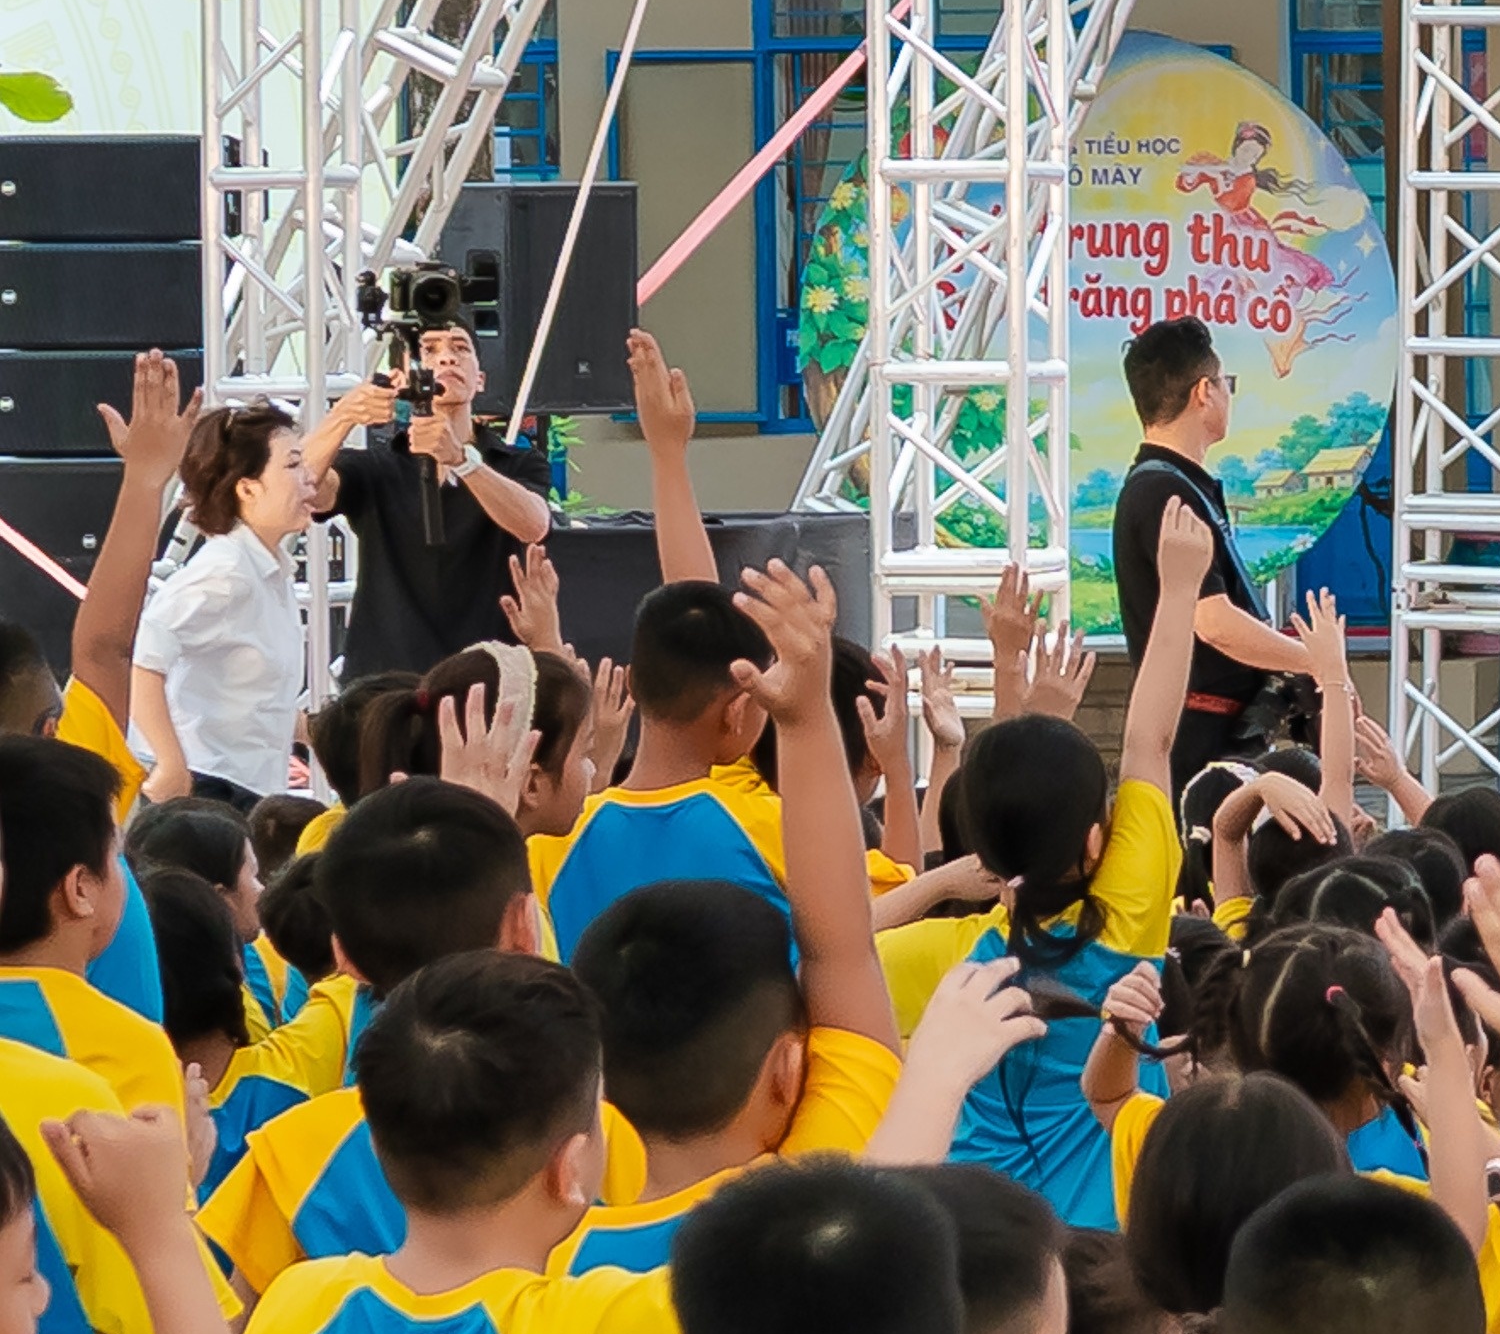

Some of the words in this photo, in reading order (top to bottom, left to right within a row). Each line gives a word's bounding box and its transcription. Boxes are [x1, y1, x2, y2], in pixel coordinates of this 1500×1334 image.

[1084, 130, 1131, 155] TIỂU
[1136, 137, 1181, 157] HỌC
[1187, 213, 1272, 273] thu
